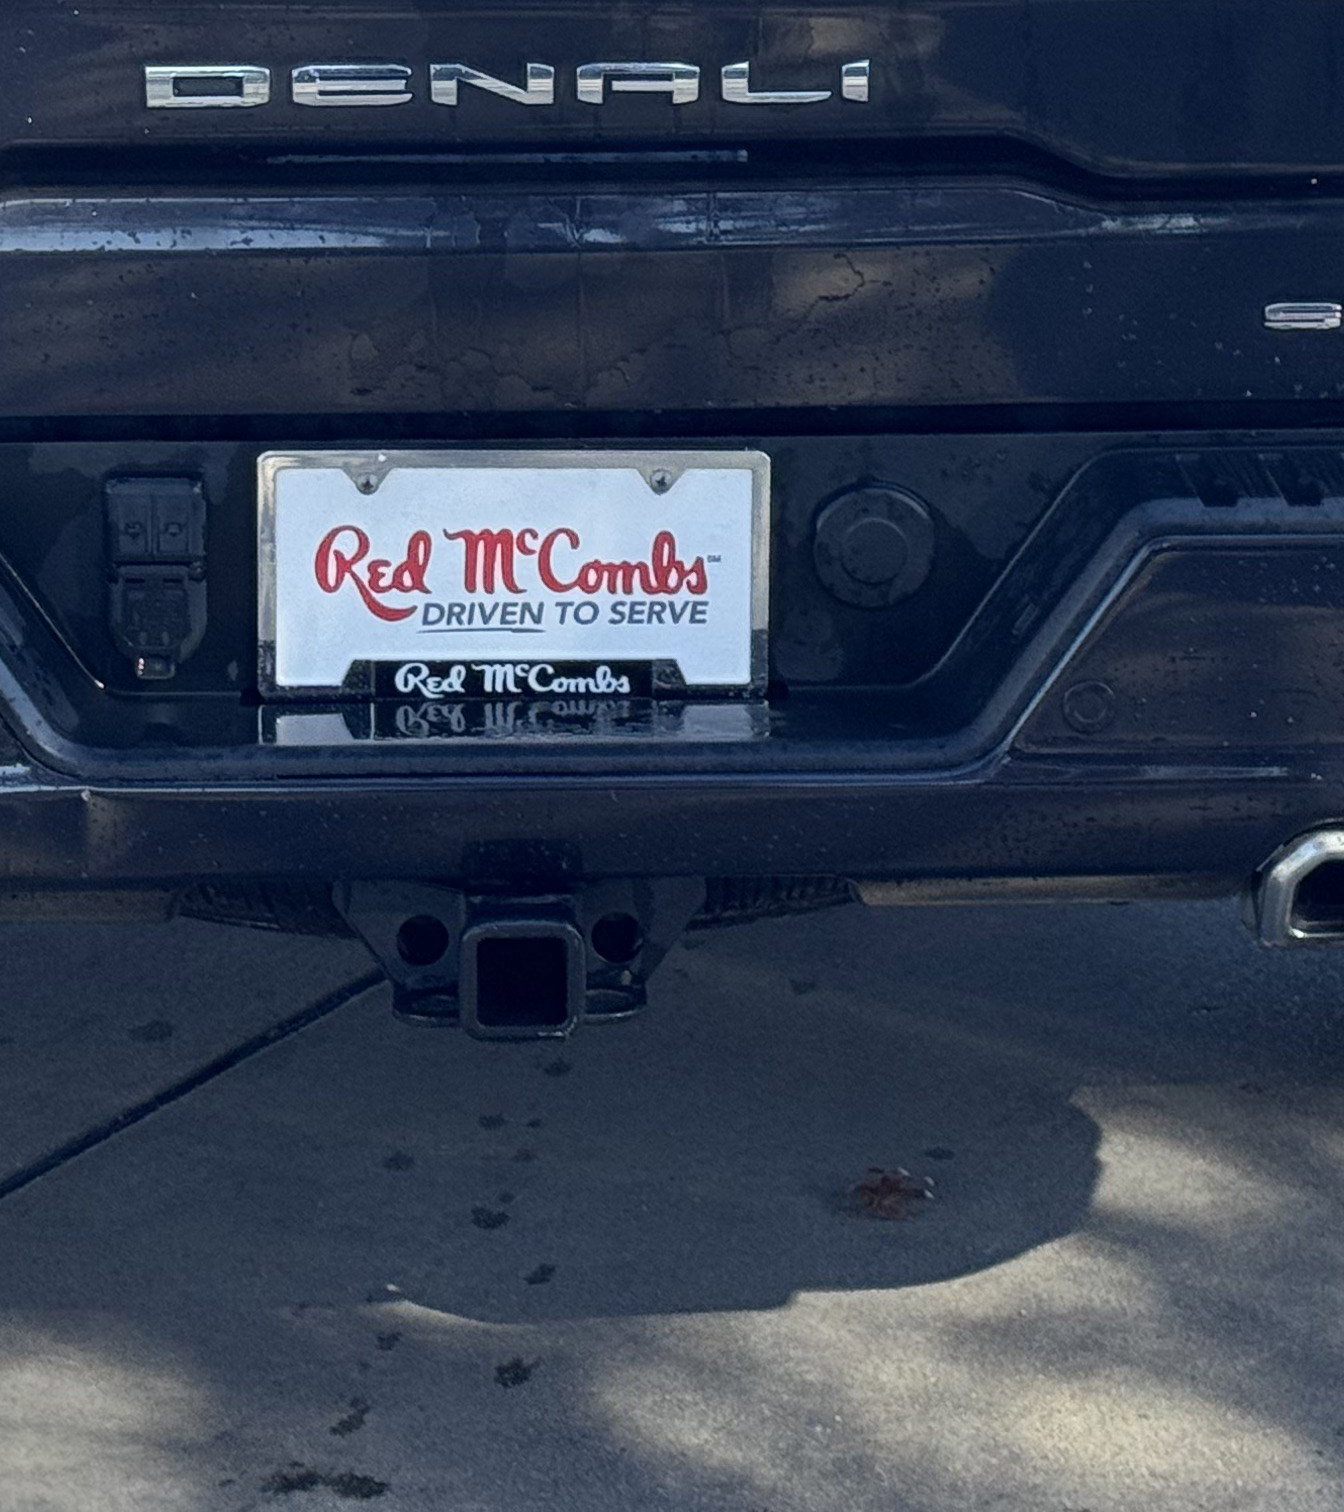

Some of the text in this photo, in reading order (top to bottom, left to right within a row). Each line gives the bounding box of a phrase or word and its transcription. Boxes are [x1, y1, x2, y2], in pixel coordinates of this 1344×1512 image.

[144, 59, 871, 108] DENALI
[314, 524, 708, 622] Red McCombs
[422, 600, 710, 626] DRIVEN TO SERVE
[395, 661, 631, 699] Red McCombs
